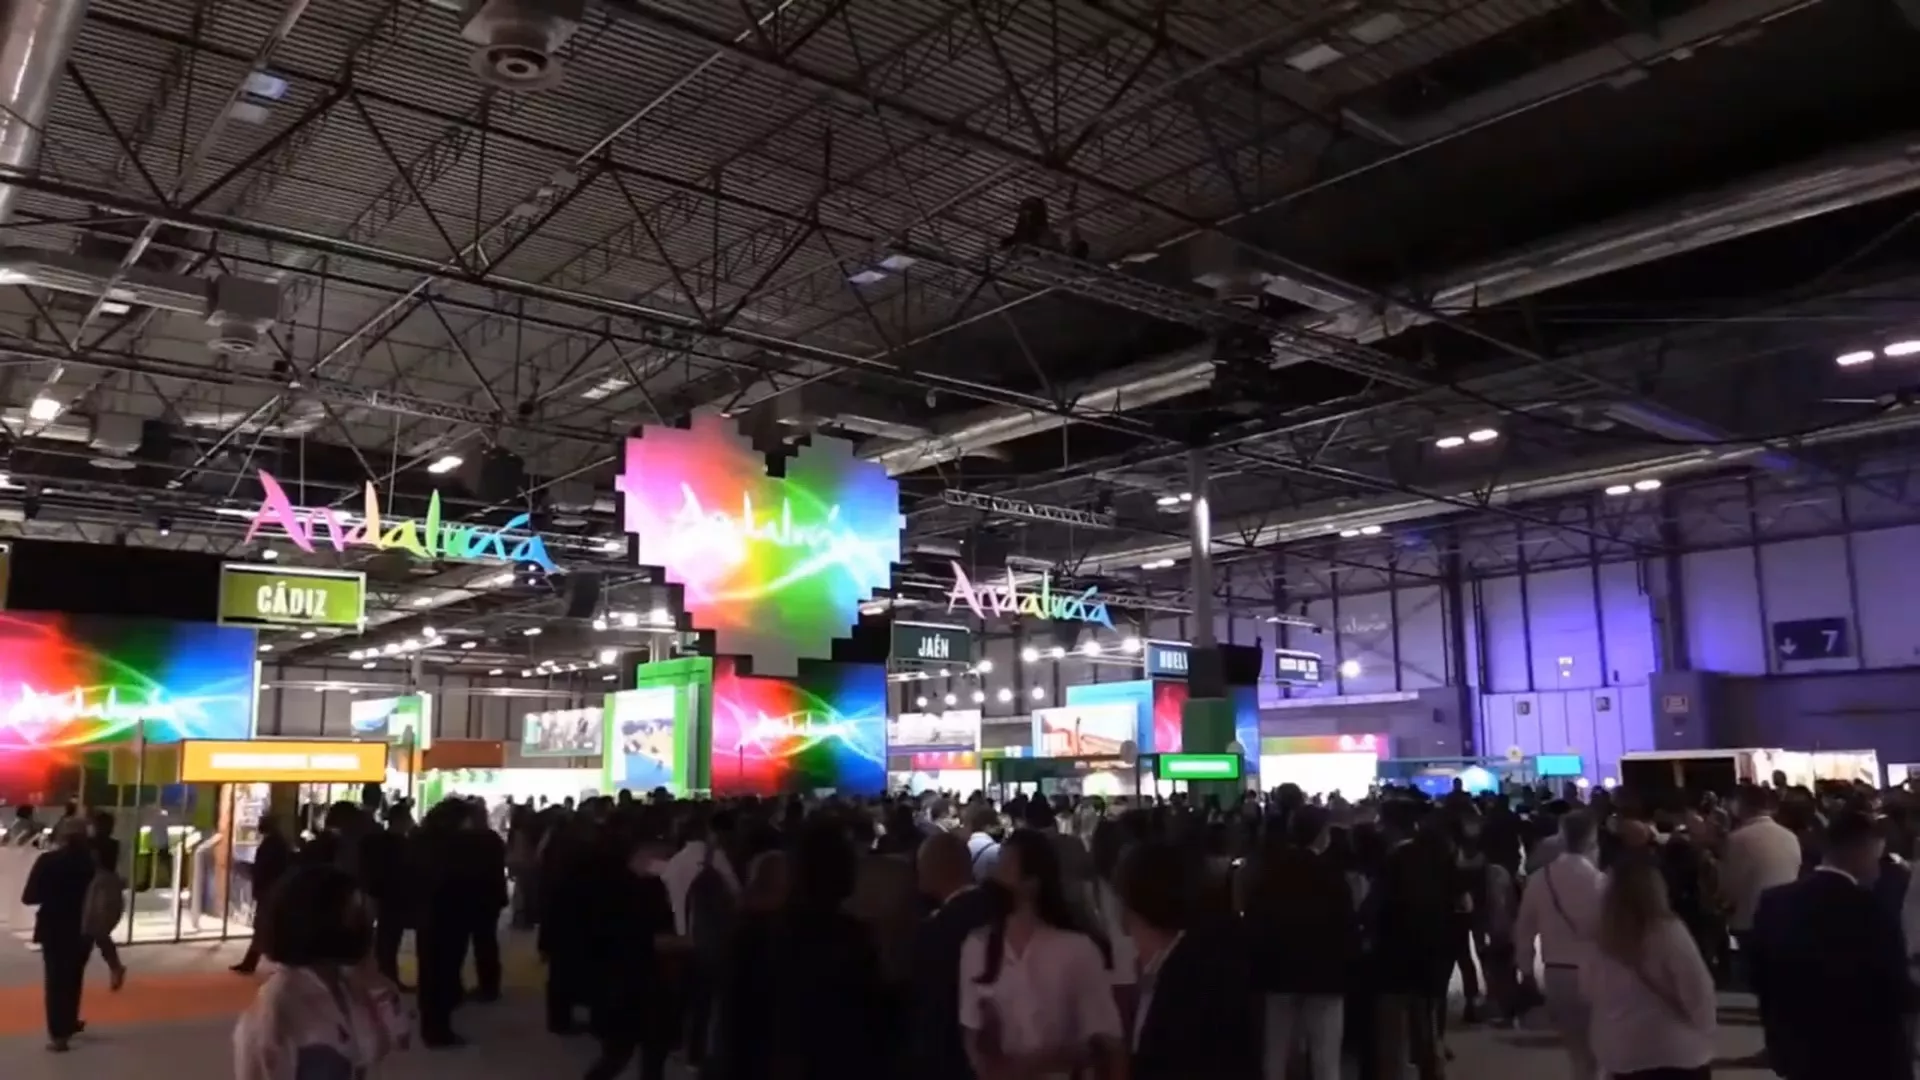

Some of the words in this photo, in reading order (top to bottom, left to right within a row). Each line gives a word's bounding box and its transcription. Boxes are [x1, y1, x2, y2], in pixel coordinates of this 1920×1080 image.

[257, 581, 328, 617] CÁDIZ
[945, 560, 1117, 632] Andalucía
[918, 634, 949, 658] JAÉN
[1820, 630, 1839, 653] 7
